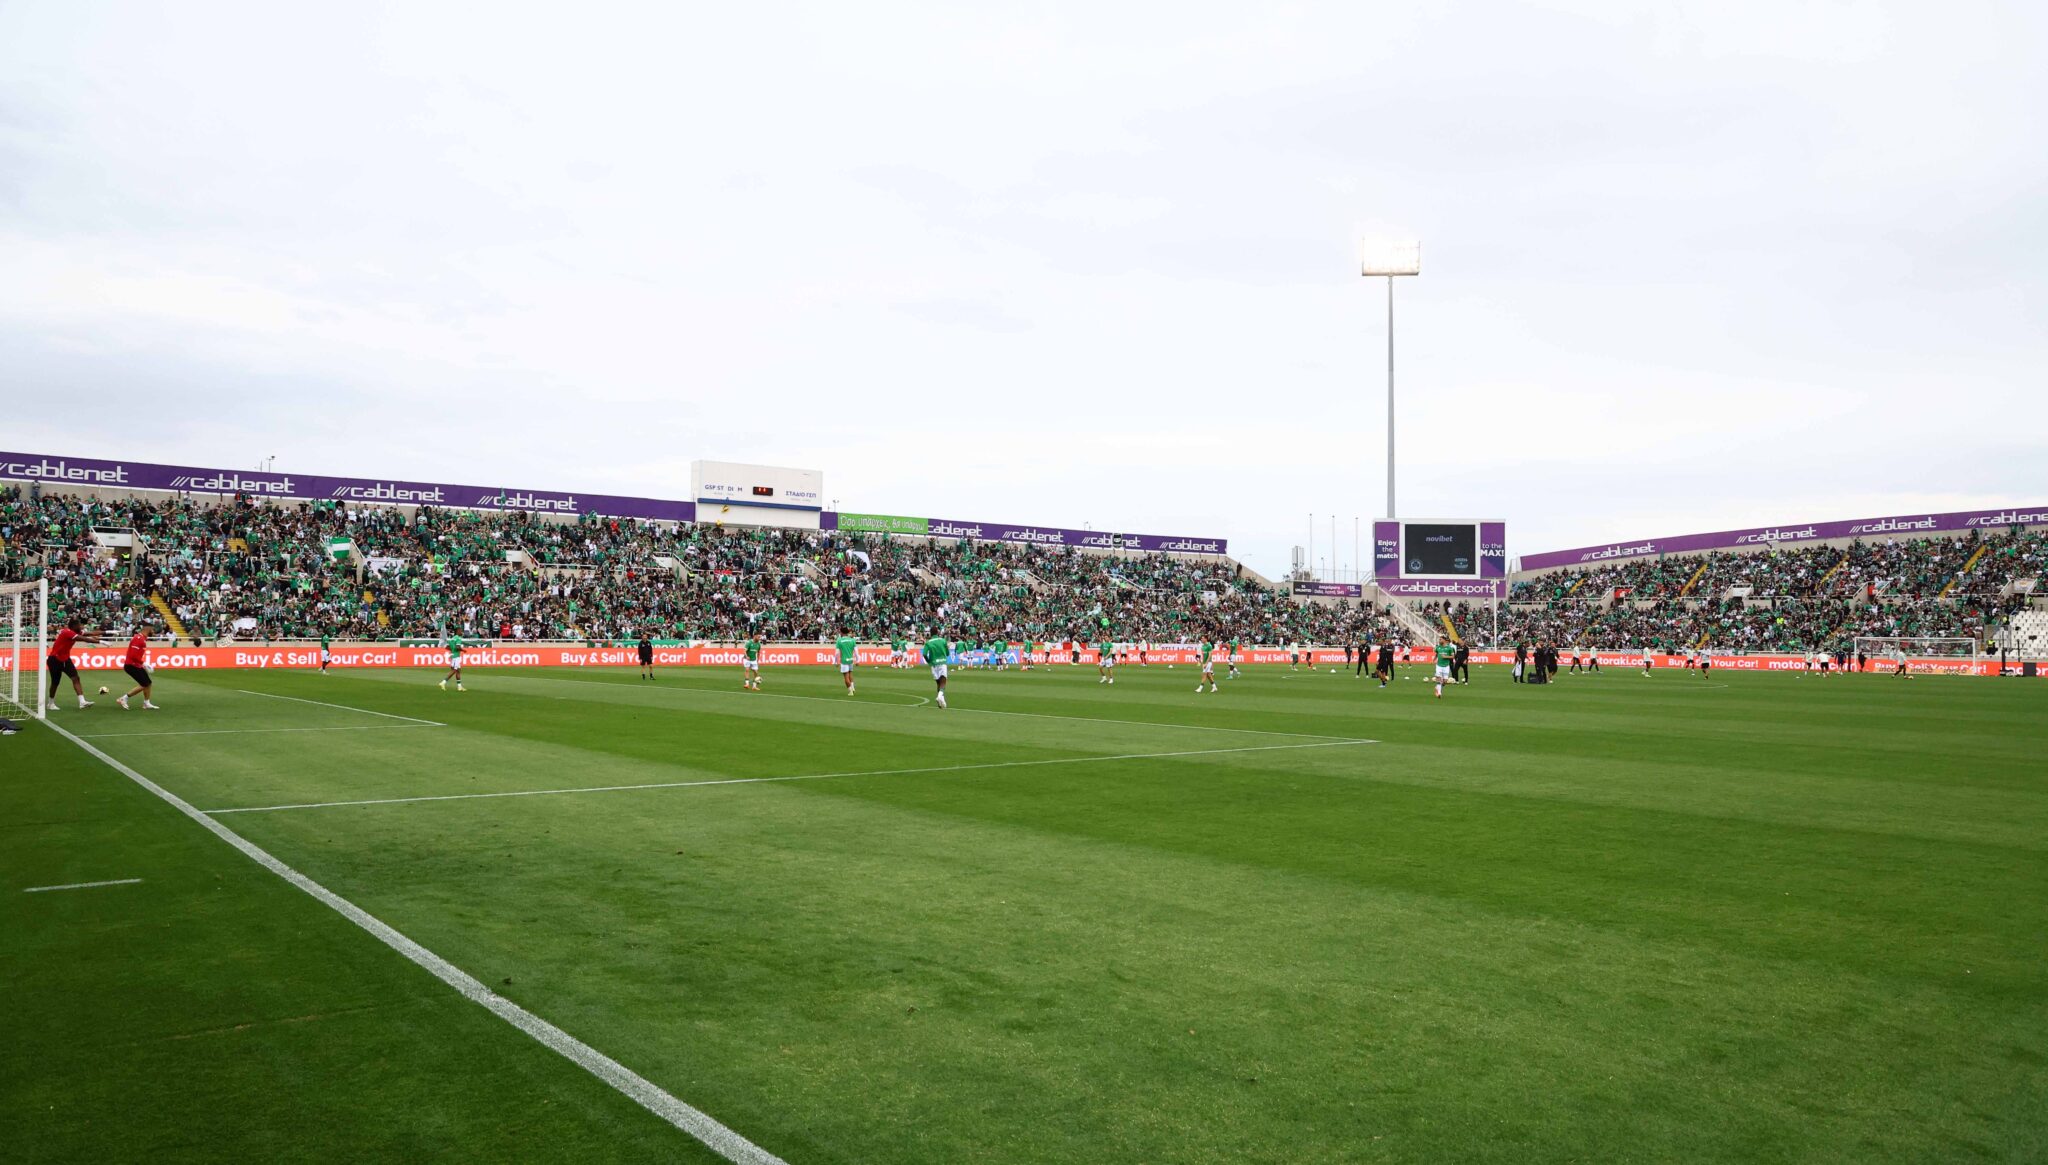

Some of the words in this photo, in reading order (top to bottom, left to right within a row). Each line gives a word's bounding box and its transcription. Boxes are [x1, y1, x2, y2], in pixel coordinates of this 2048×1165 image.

[8, 460, 128, 483] cablenet
[190, 473, 295, 494] cablenet
[350, 483, 445, 502] cablenet
[493, 492, 577, 511] cablenet
[1862, 517, 1936, 533] cablenet
[1012, 528, 1064, 543] cablenet
[1425, 535, 1453, 543] novibet
[1748, 526, 1817, 542] cablenet
[1090, 536, 1141, 548] cablnet
[1168, 540, 1218, 552] cablenet
[1378, 539, 1398, 547] Enjoy
[1480, 549, 1505, 557] MAX!
[1592, 542, 1655, 560] cablenet
[236, 652, 269, 668] Buy
[272, 653, 284, 665] &
[288, 652, 317, 665] Sell
[321, 652, 359, 665] our
[362, 651, 397, 665] Car!
[413, 650, 540, 665] motraki.com
[561, 651, 587, 666] Buy
[589, 652, 599, 664] &
[601, 651, 625, 664] Sell
[659, 651, 687, 664] Car!
[1669, 658, 1685, 669] Buy
[1714, 659, 1736, 668] Your
[1738, 659, 1759, 669] Car!
